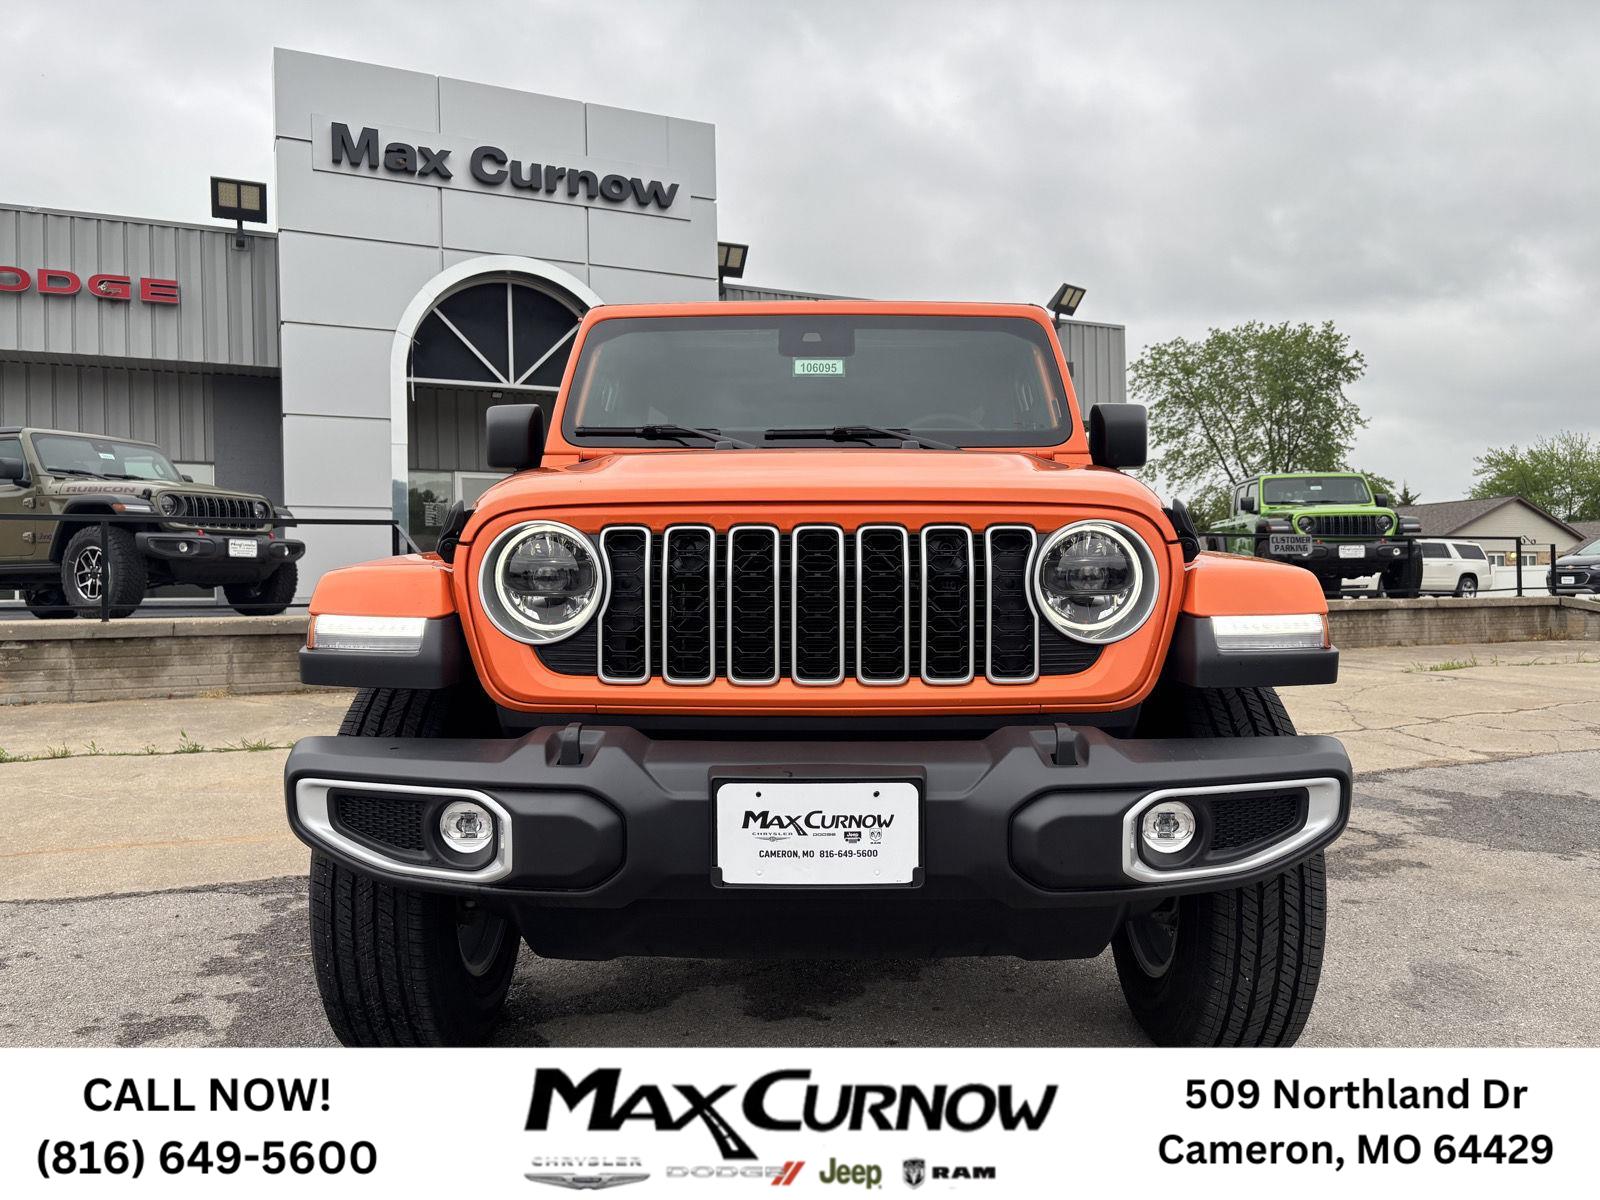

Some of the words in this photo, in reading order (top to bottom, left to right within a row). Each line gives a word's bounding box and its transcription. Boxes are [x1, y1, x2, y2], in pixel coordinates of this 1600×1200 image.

[331, 121, 453, 179] Max
[470, 145, 680, 209] Curnow
[800, 362, 837, 373] 106095
[66, 485, 136, 494] RUBICON
[1271, 536, 1311, 544] CUSTOMER
[1274, 544, 1308, 552] PARKING
[759, 850, 801, 859] CAMERON,
[802, 850, 815, 858] MO
[819, 850, 878, 858] 816-649-5600
